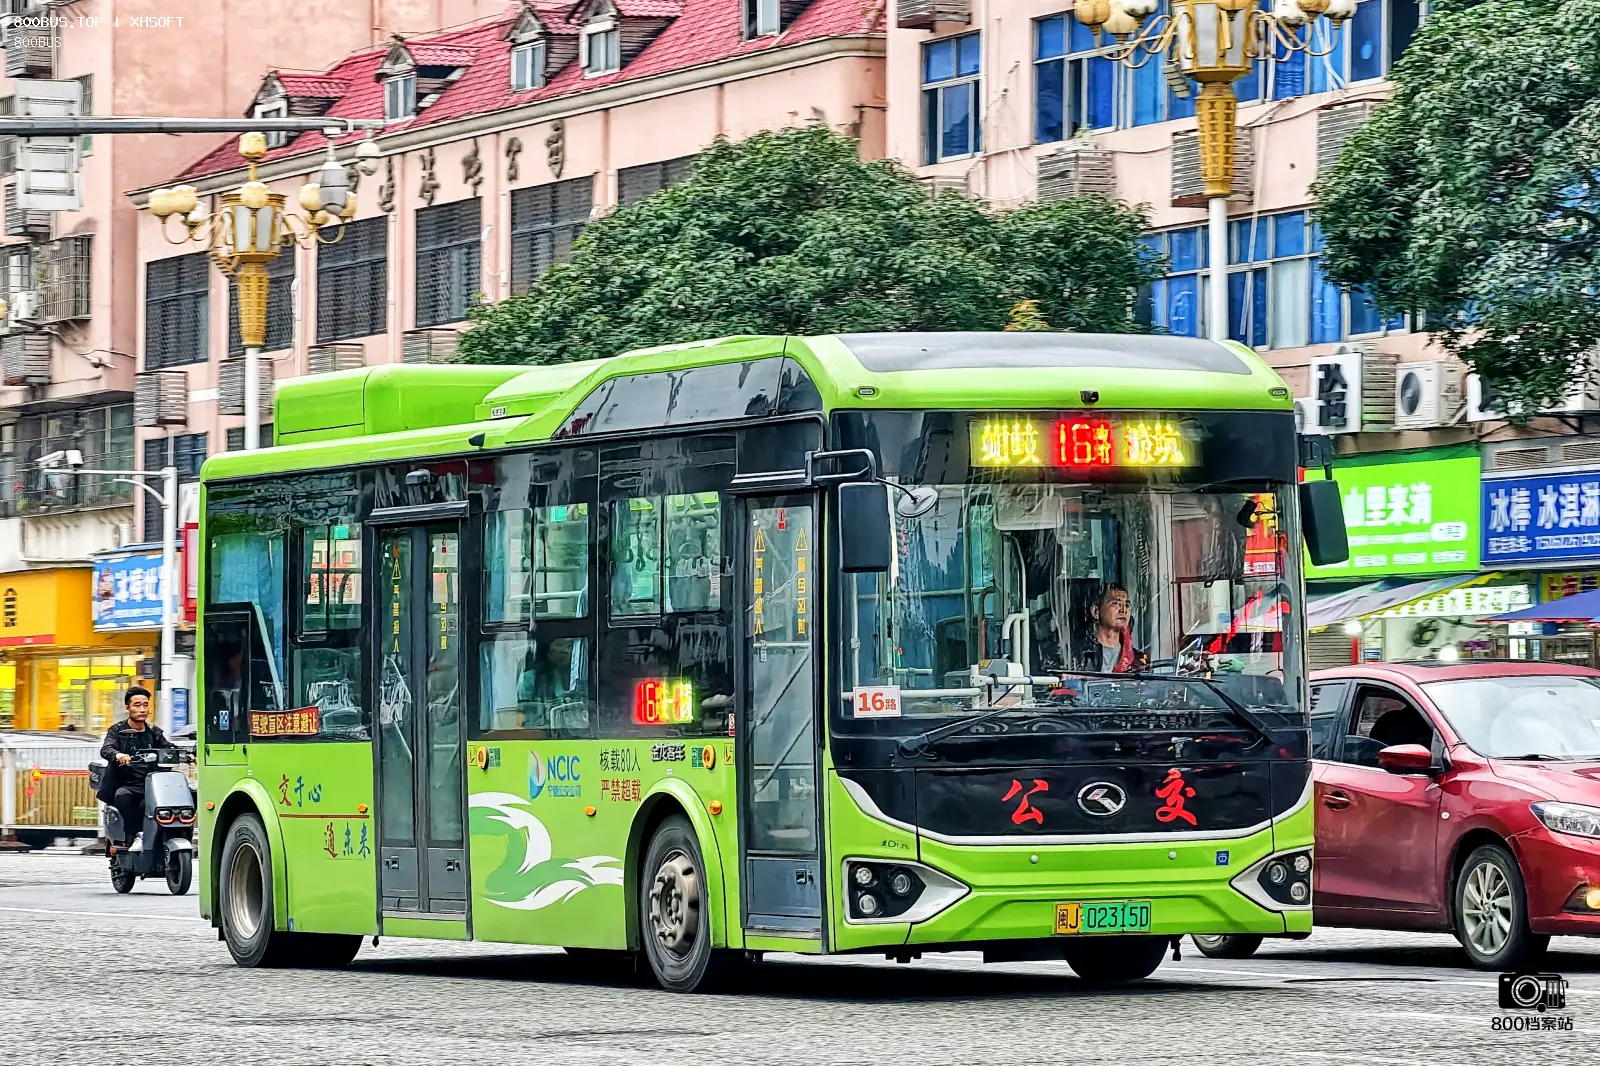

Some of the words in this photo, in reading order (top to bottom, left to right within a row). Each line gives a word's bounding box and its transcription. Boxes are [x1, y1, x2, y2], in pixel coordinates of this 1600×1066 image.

[858, 691, 897, 712] 16路
[251, 711, 318, 734] 驾驶盲区注意避让
[547, 755, 581, 782] NCIC
[600, 748, 641, 773] 核载80人
[601, 778, 642, 803] 严禁超载
[1002, 779, 1049, 825] 公
[1155, 768, 1198, 826] 交
